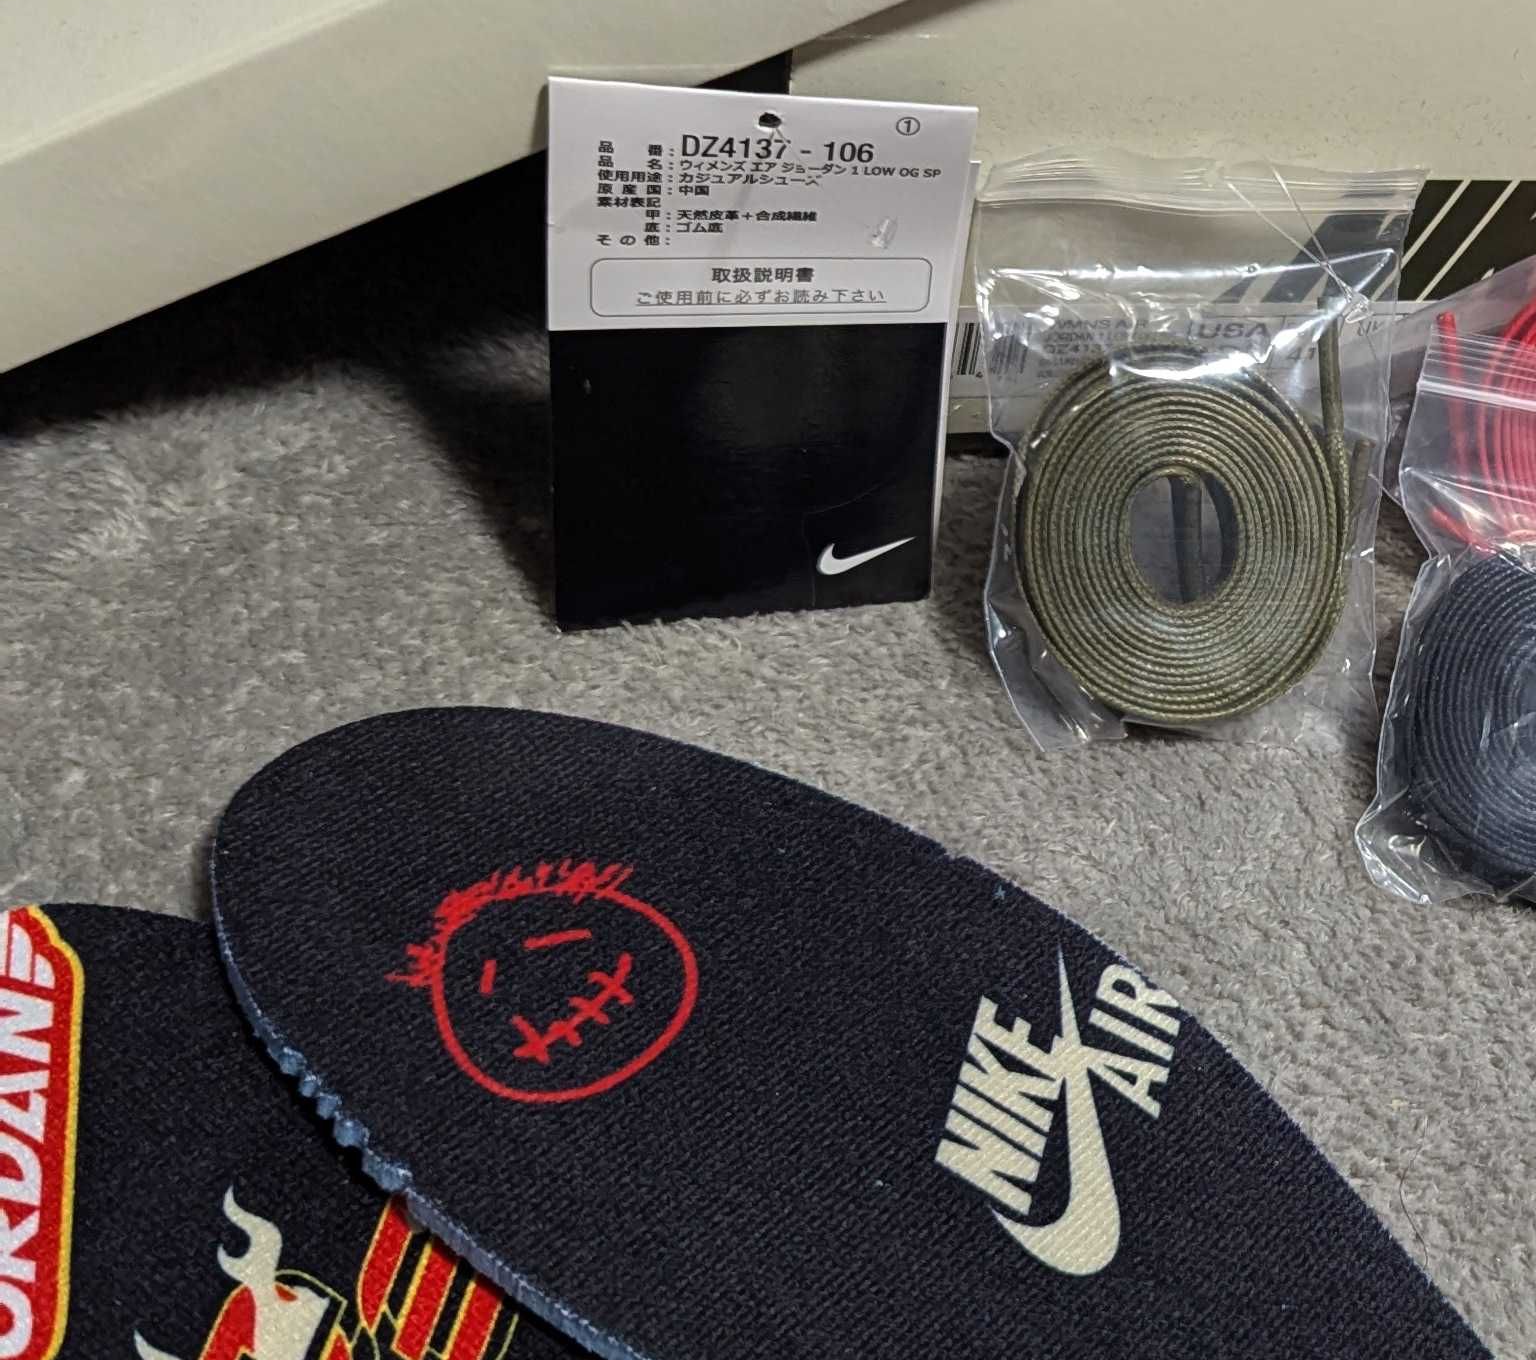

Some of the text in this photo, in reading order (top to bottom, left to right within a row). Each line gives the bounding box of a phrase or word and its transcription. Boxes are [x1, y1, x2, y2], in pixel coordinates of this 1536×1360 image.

[681, 134, 792, 160] DZ4137
[823, 141, 875, 164] 106
[863, 166, 896, 177] LOW
[899, 167, 920, 178] OG
[922, 168, 942, 178] SP
[679, 185, 711, 197] 中国
[711, 266, 816, 284] 取扱説明書
[636, 288, 887, 306] ご使用前に必ずお読み下さい
[1086, 962, 1182, 1121] AIR
[934, 993, 1066, 1216] NIKE
